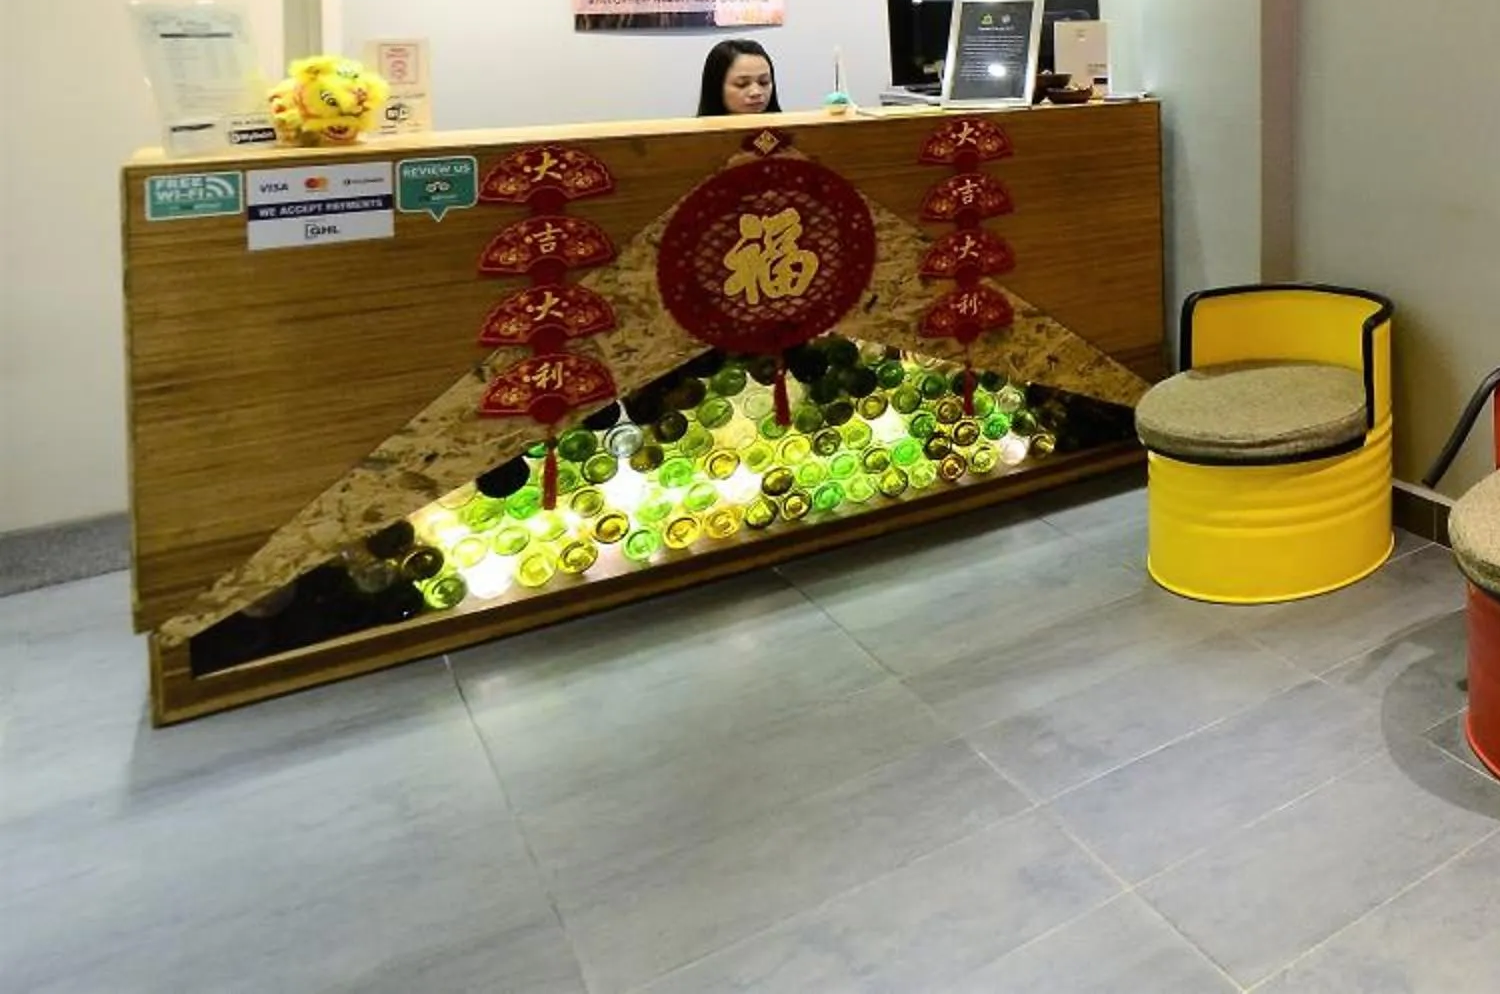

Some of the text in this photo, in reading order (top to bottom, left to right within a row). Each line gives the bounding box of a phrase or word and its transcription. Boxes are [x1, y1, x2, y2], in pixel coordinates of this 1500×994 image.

[403, 163, 471, 177] REVIEW US
[155, 177, 204, 190] FREE
[260, 183, 289, 193] VISA
[259, 198, 383, 217] WE ACCEPT PAYMENTS
[956, 121, 979, 316] 大 吉 大 利
[723, 207, 819, 305] 福
[531, 151, 564, 390] 大 吉 大 利
